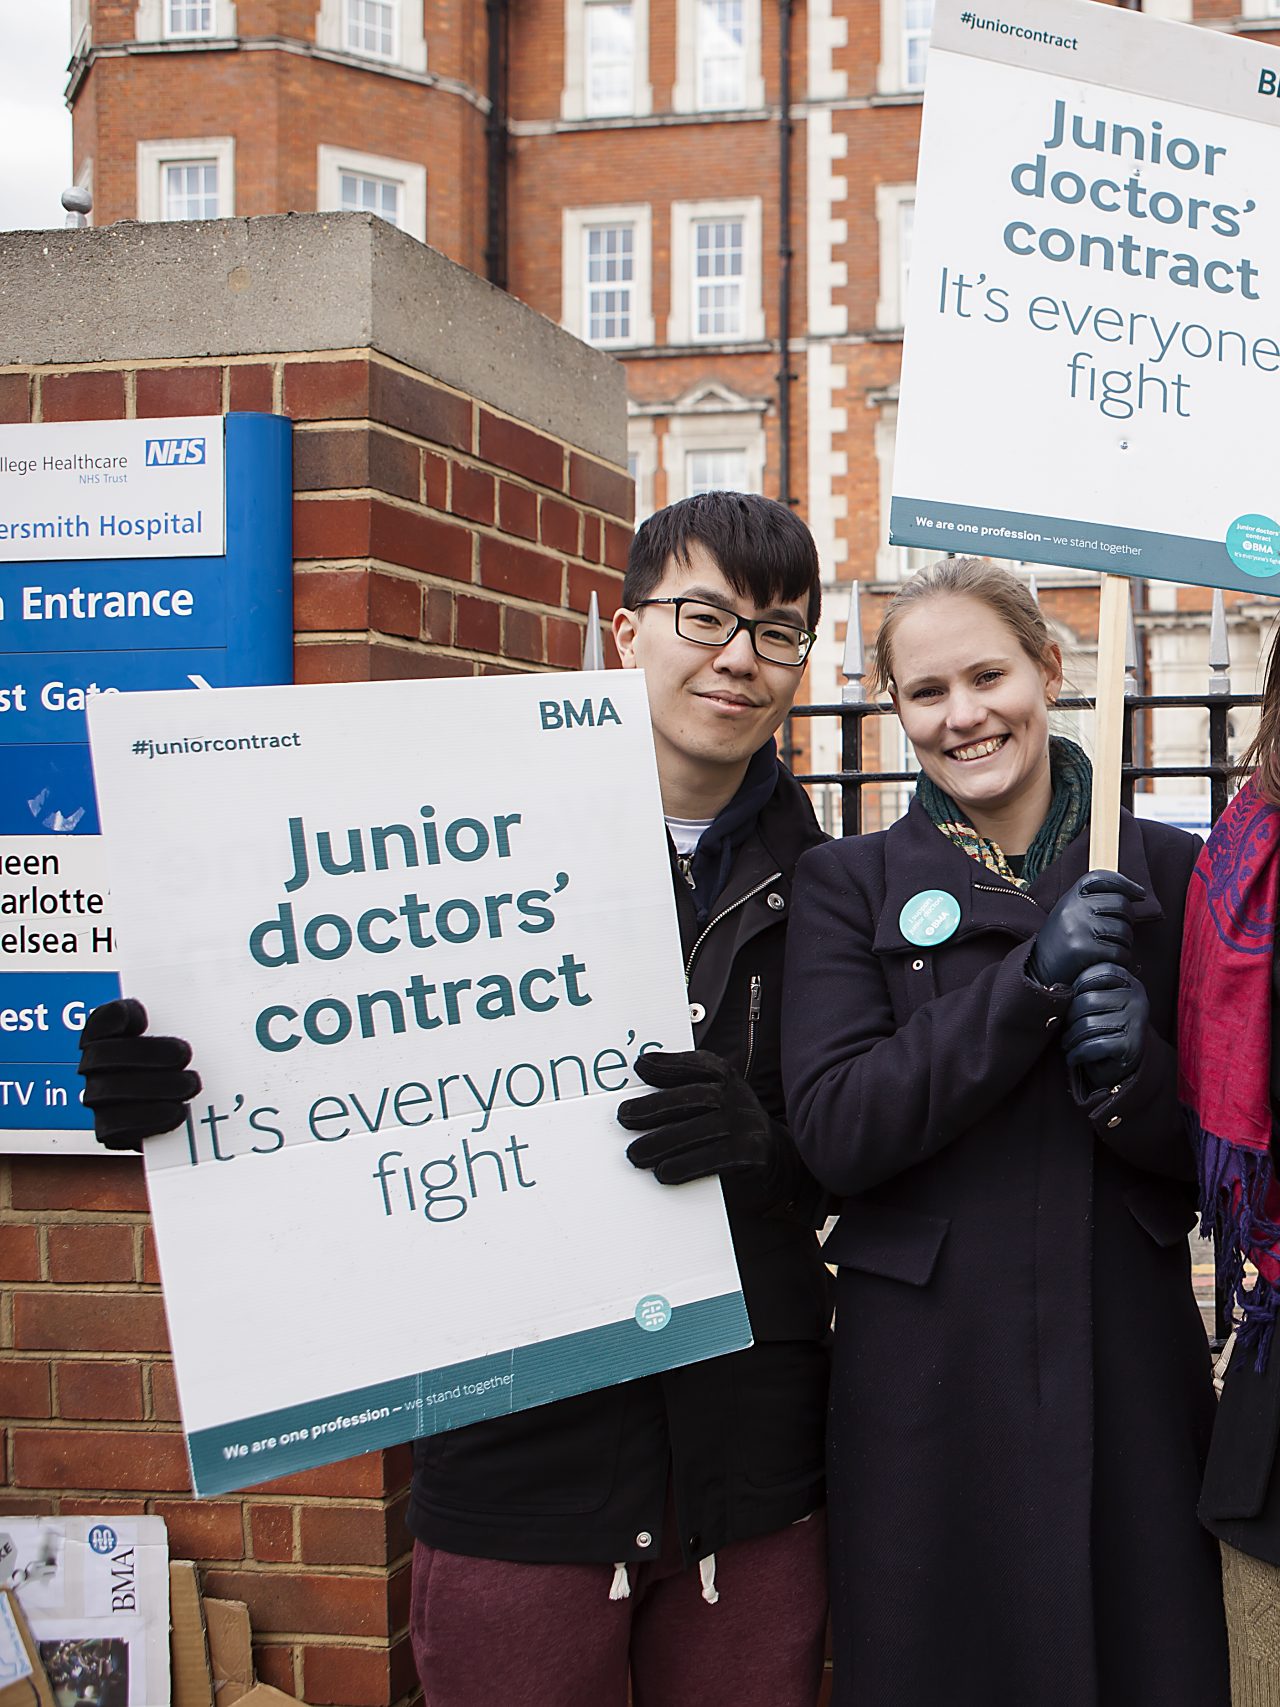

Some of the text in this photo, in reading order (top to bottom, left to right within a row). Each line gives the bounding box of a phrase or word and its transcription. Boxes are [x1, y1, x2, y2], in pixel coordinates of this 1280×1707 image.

[960, 10, 1078, 51] #juniorcontract
[1044, 100, 1227, 176] Junior
[1010, 154, 1256, 238] doctors’
[1003, 220, 1260, 300] contract
[938, 267, 1010, 323] It’s
[1066, 352, 1191, 419] fight
[43, 455, 128, 471] Healthcare
[146, 439, 205, 466] NHS
[79, 473, 128, 484] NHS Trust
[100, 511, 202, 541] Hospital
[916, 516, 934, 528] We
[936, 520, 954, 531] are
[957, 523, 979, 534] one
[981, 526, 1041, 542] profession
[1053, 536, 1068, 546] we
[1070, 538, 1098, 550] stand
[1100, 541, 1142, 556] together
[1252, 542, 1274, 555] BMA
[22, 586, 194, 620] Entrance
[539, 698, 622, 730] BMA
[132, 732, 301, 759] #juniorcontract
[283, 804, 522, 893] Junior
[1, 925, 78, 954] elsea
[248, 871, 570, 968] doctors’
[0, 1004, 49, 1032] est
[254, 953, 592, 1053] contract
[45, 1080, 68, 1107] in
[182, 1094, 286, 1167] It’s
[372, 1133, 537, 1224] fight
[223, 1443, 249, 1460] We
[251, 1437, 277, 1453] are
[279, 1429, 309, 1445] one
[311, 1406, 390, 1440] profession
[404, 1398, 424, 1411] we
[426, 1386, 461, 1406] stand
[462, 1373, 515, 1395] together
[111, 1547, 136, 1613] BMA
